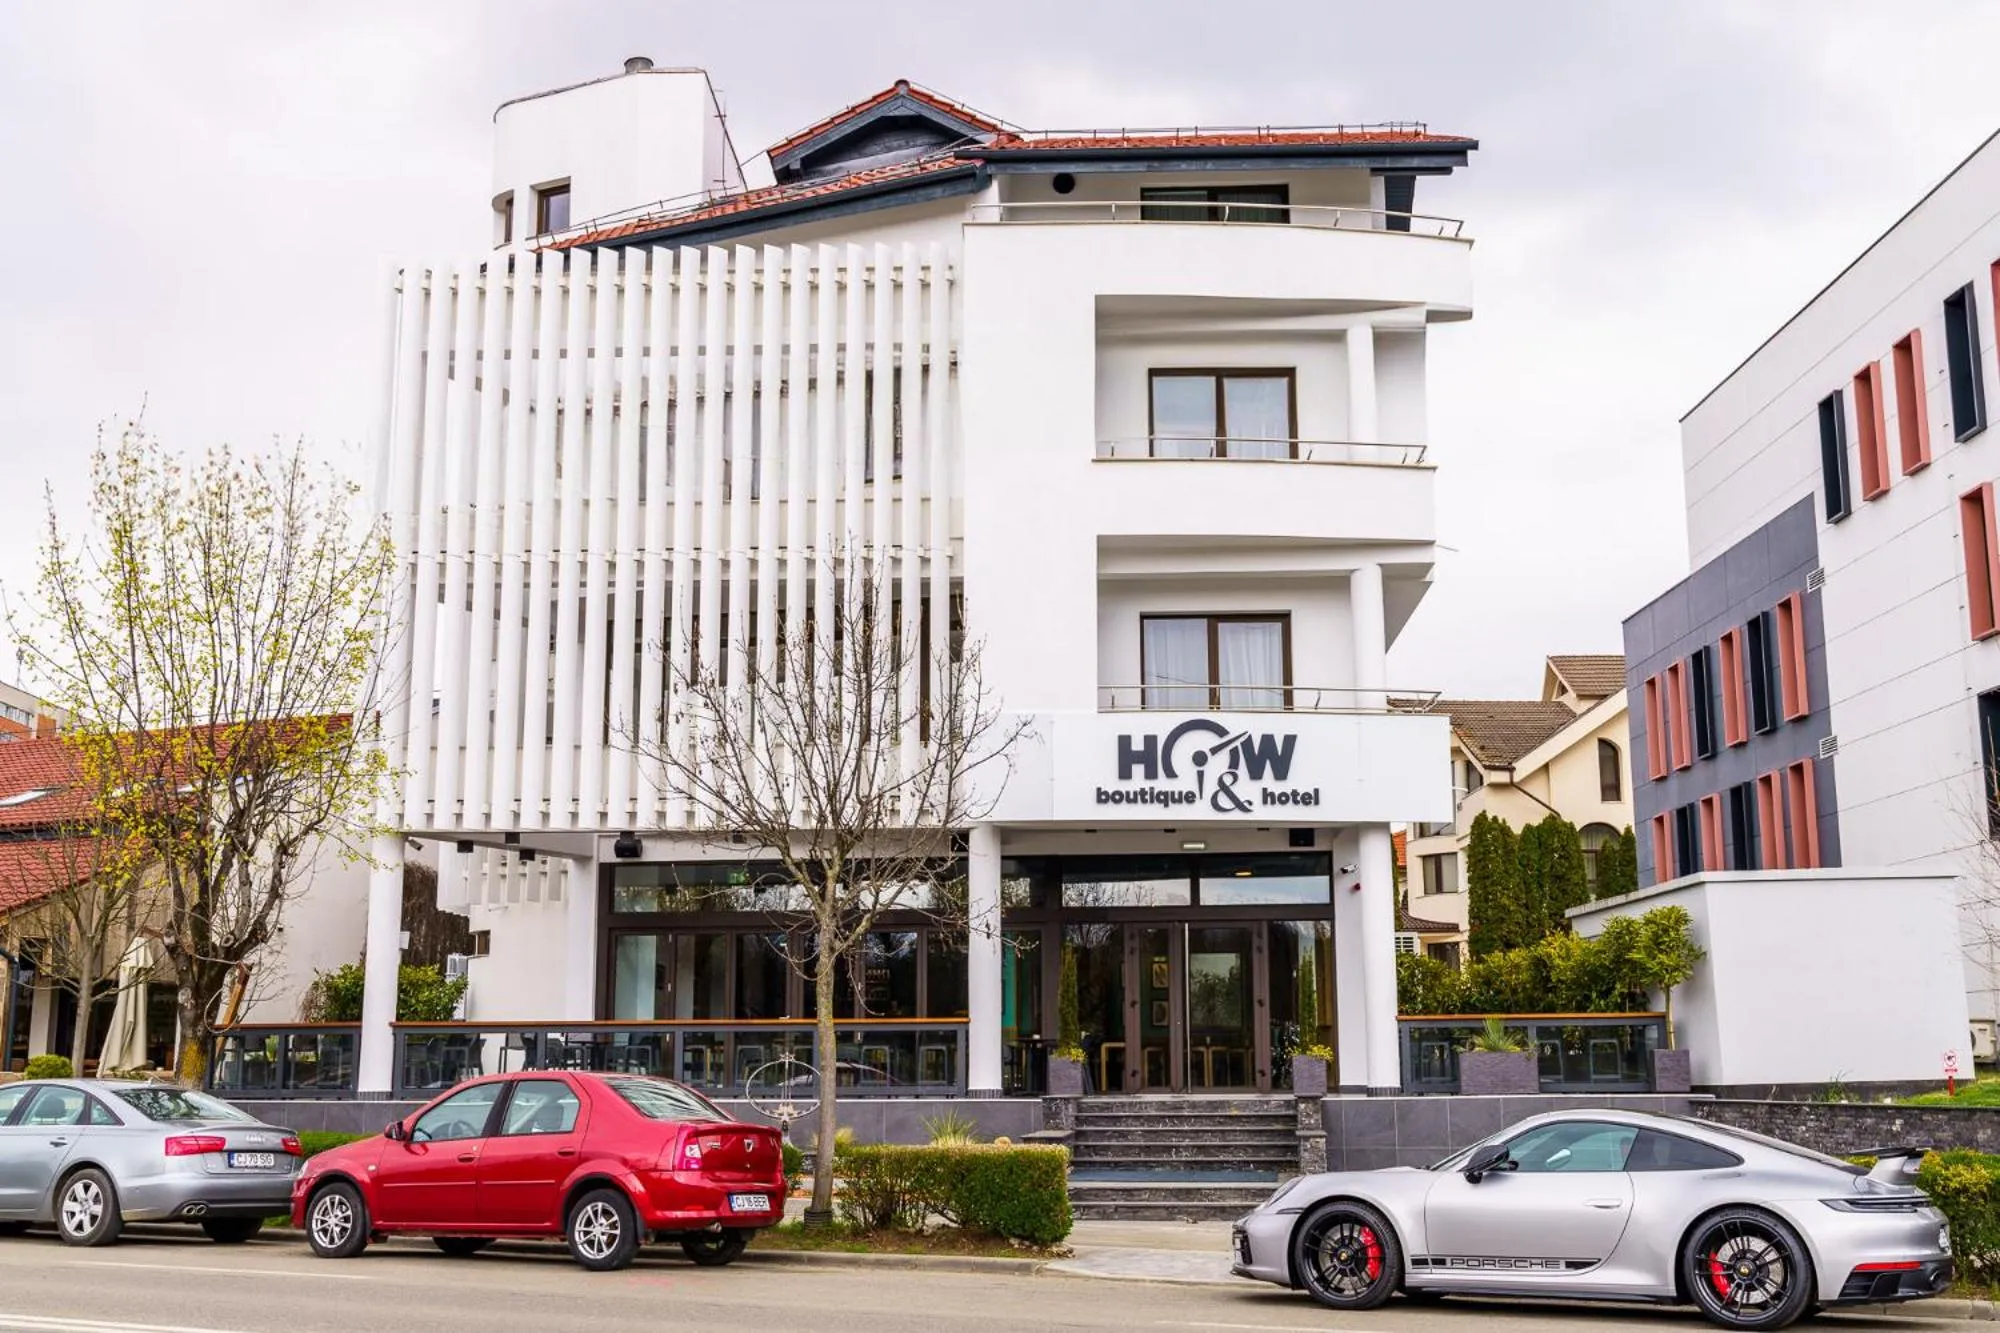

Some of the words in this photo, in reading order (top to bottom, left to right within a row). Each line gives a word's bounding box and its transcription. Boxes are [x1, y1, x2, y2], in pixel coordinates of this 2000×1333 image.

[1118, 719, 1297, 780] HOW
[1096, 787, 1196, 807] boutique
[1210, 771, 1253, 812] &
[1262, 788, 1320, 805] hotel
[1451, 1258, 1561, 1269] PORSCHE
